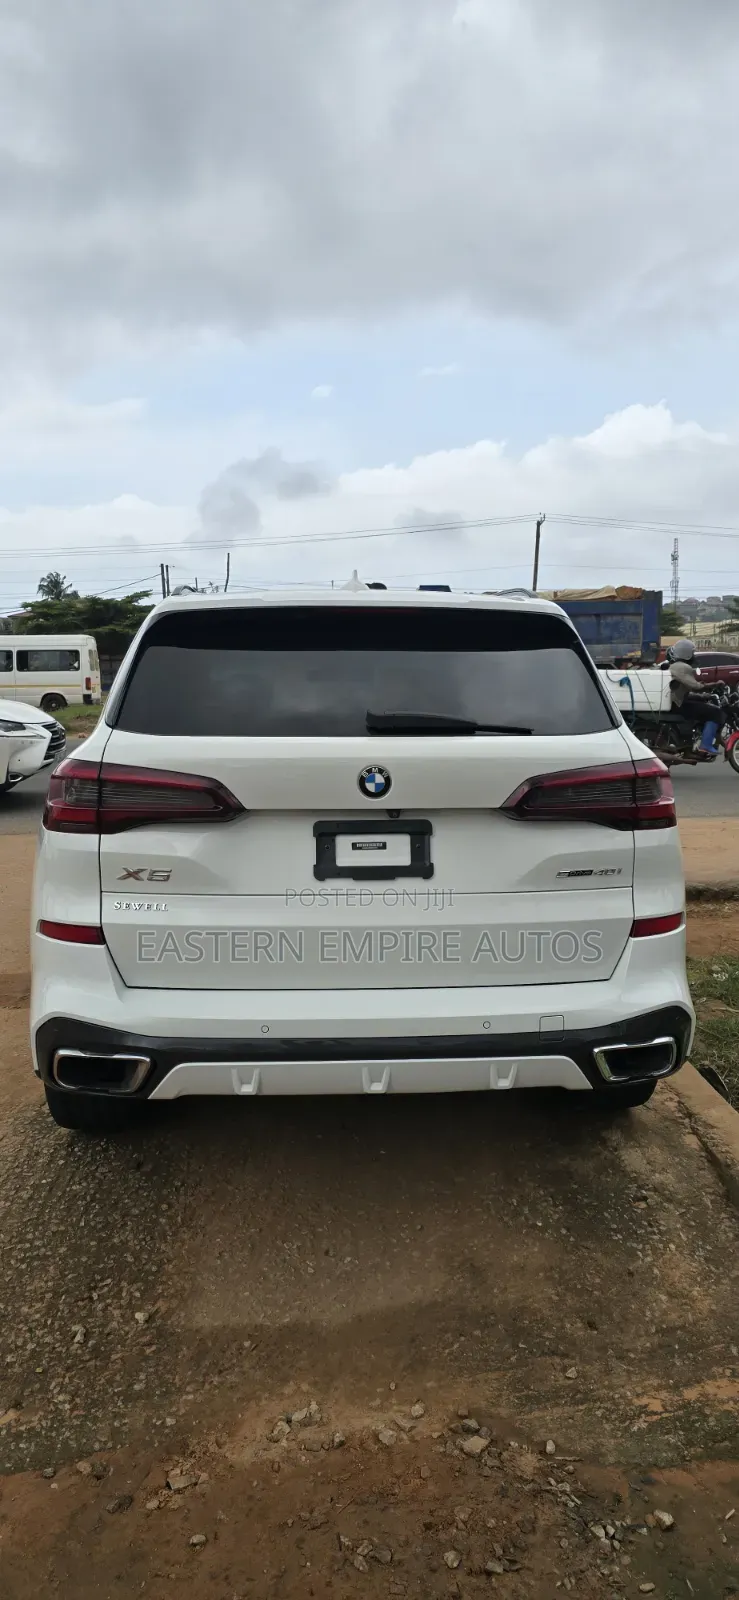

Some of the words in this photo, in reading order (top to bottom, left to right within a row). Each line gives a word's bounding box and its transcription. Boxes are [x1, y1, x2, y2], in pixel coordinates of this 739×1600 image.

[361, 767, 389, 778] BMW
[116, 867, 173, 882] X5
[113, 901, 169, 912] SEWELL
